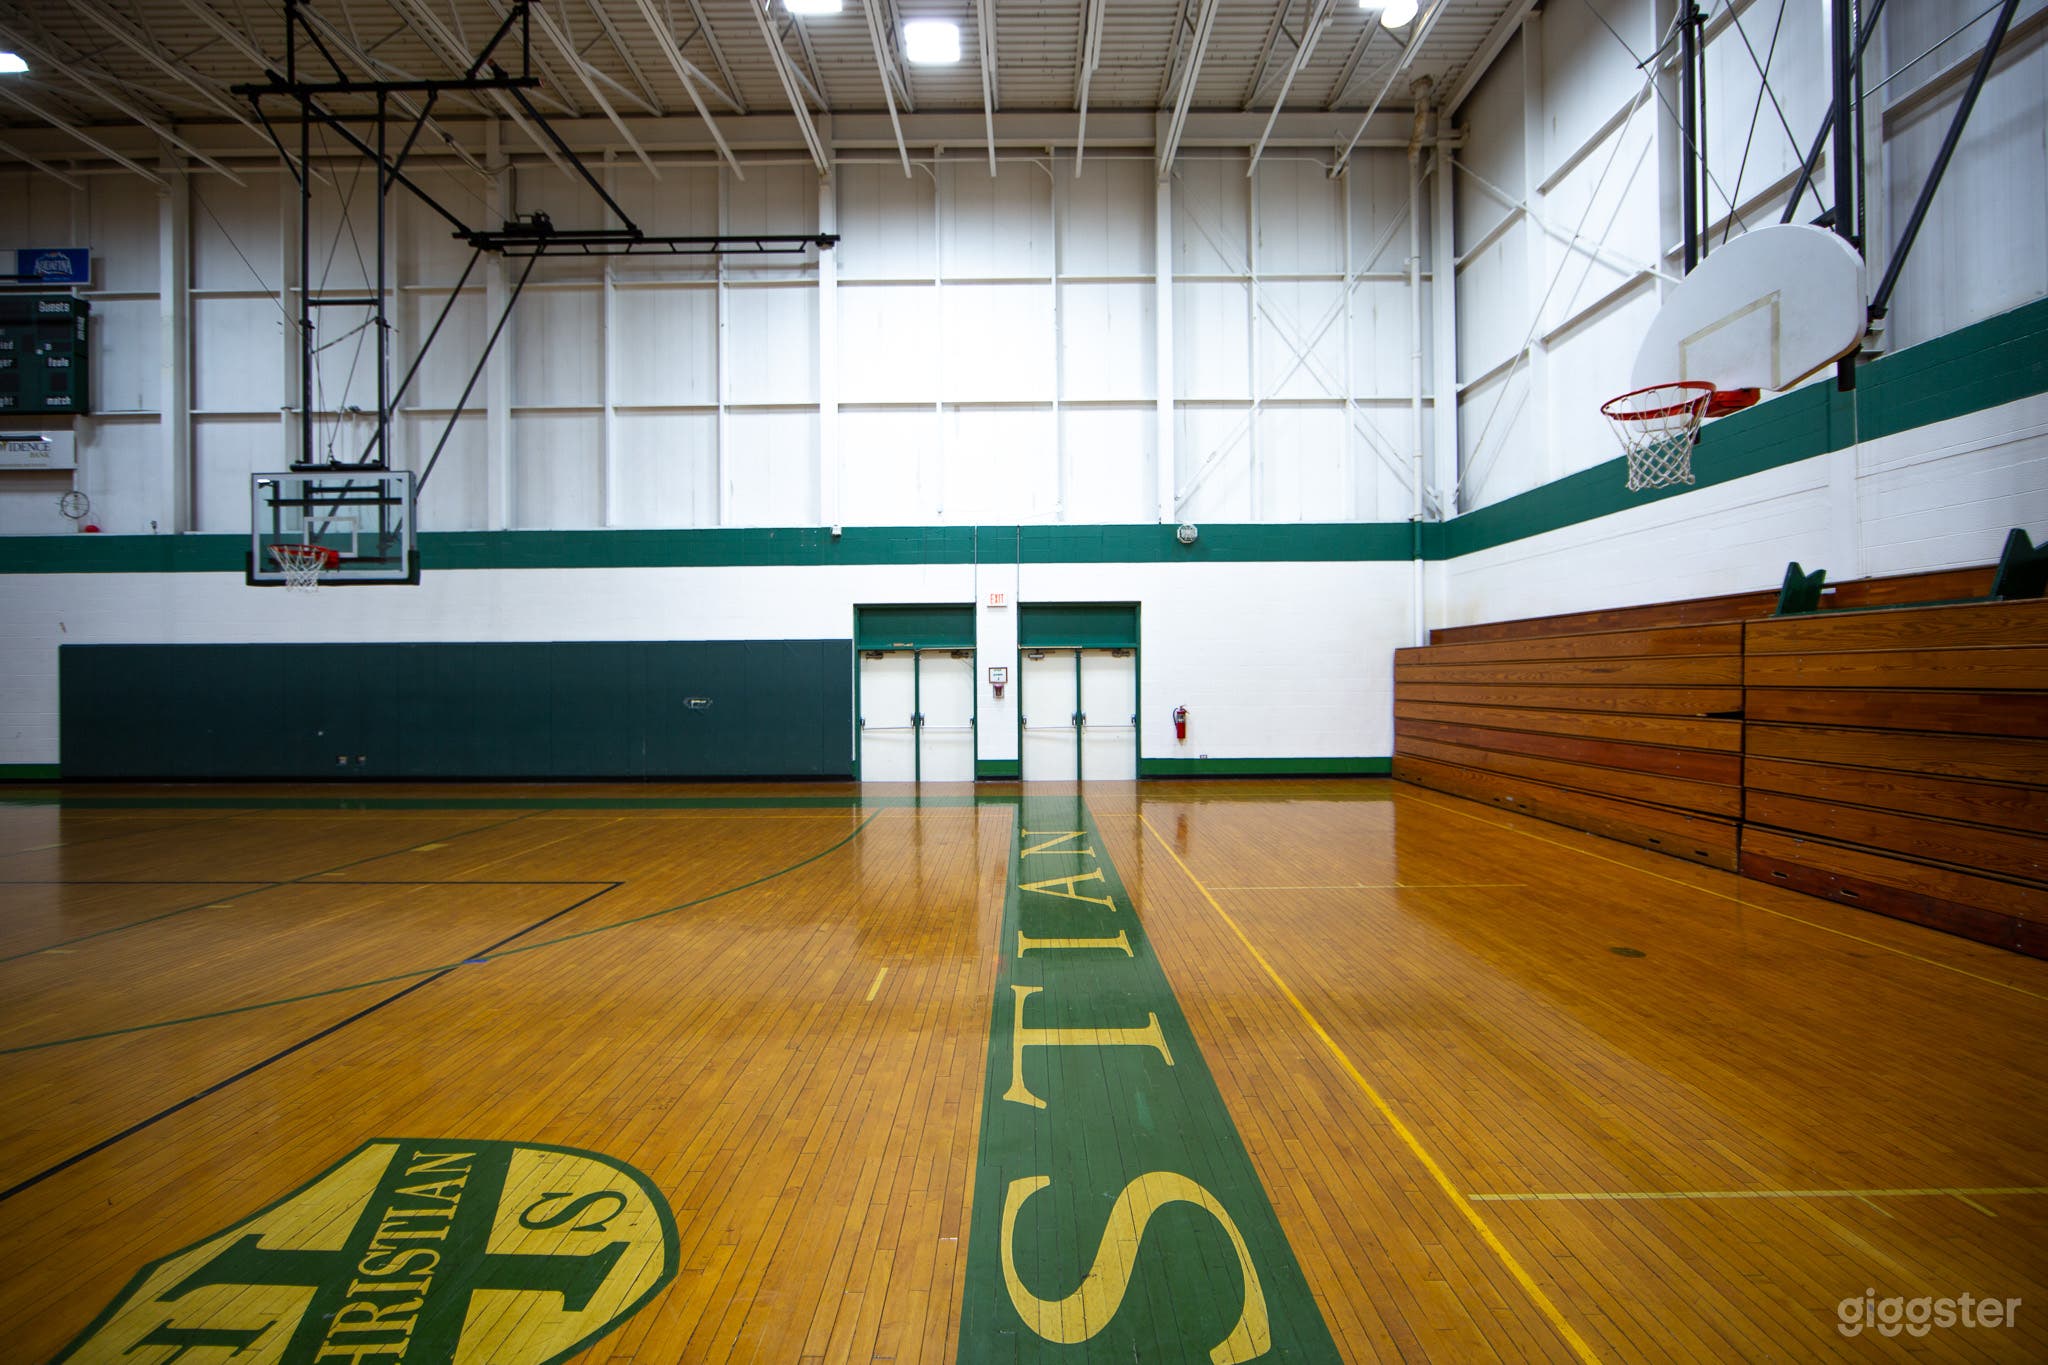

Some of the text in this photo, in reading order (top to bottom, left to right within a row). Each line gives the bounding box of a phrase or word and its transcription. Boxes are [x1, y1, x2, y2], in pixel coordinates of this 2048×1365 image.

[38, 301, 70, 312] Guests
[990, 593, 1004, 604] EXIT
[1001, 828, 1272, 1365] STIAN
